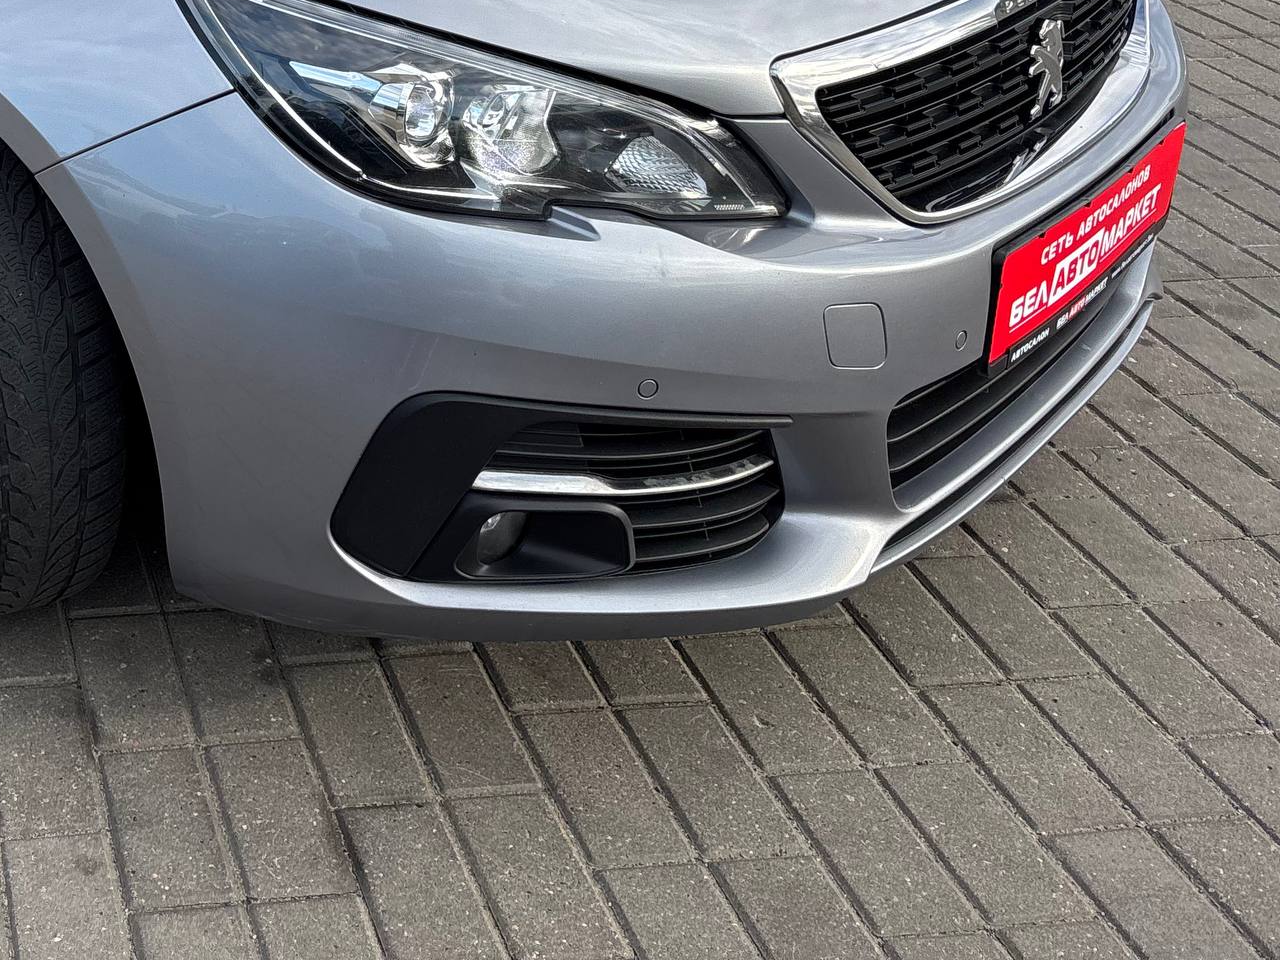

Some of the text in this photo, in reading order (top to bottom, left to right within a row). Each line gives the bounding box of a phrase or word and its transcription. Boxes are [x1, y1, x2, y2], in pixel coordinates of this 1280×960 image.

[1040, 231, 1075, 266] СЕТЬ
[1076, 164, 1152, 241] АВТОСАЛОНОВ
[1010, 327, 1050, 363] АВТОСАЛОН
